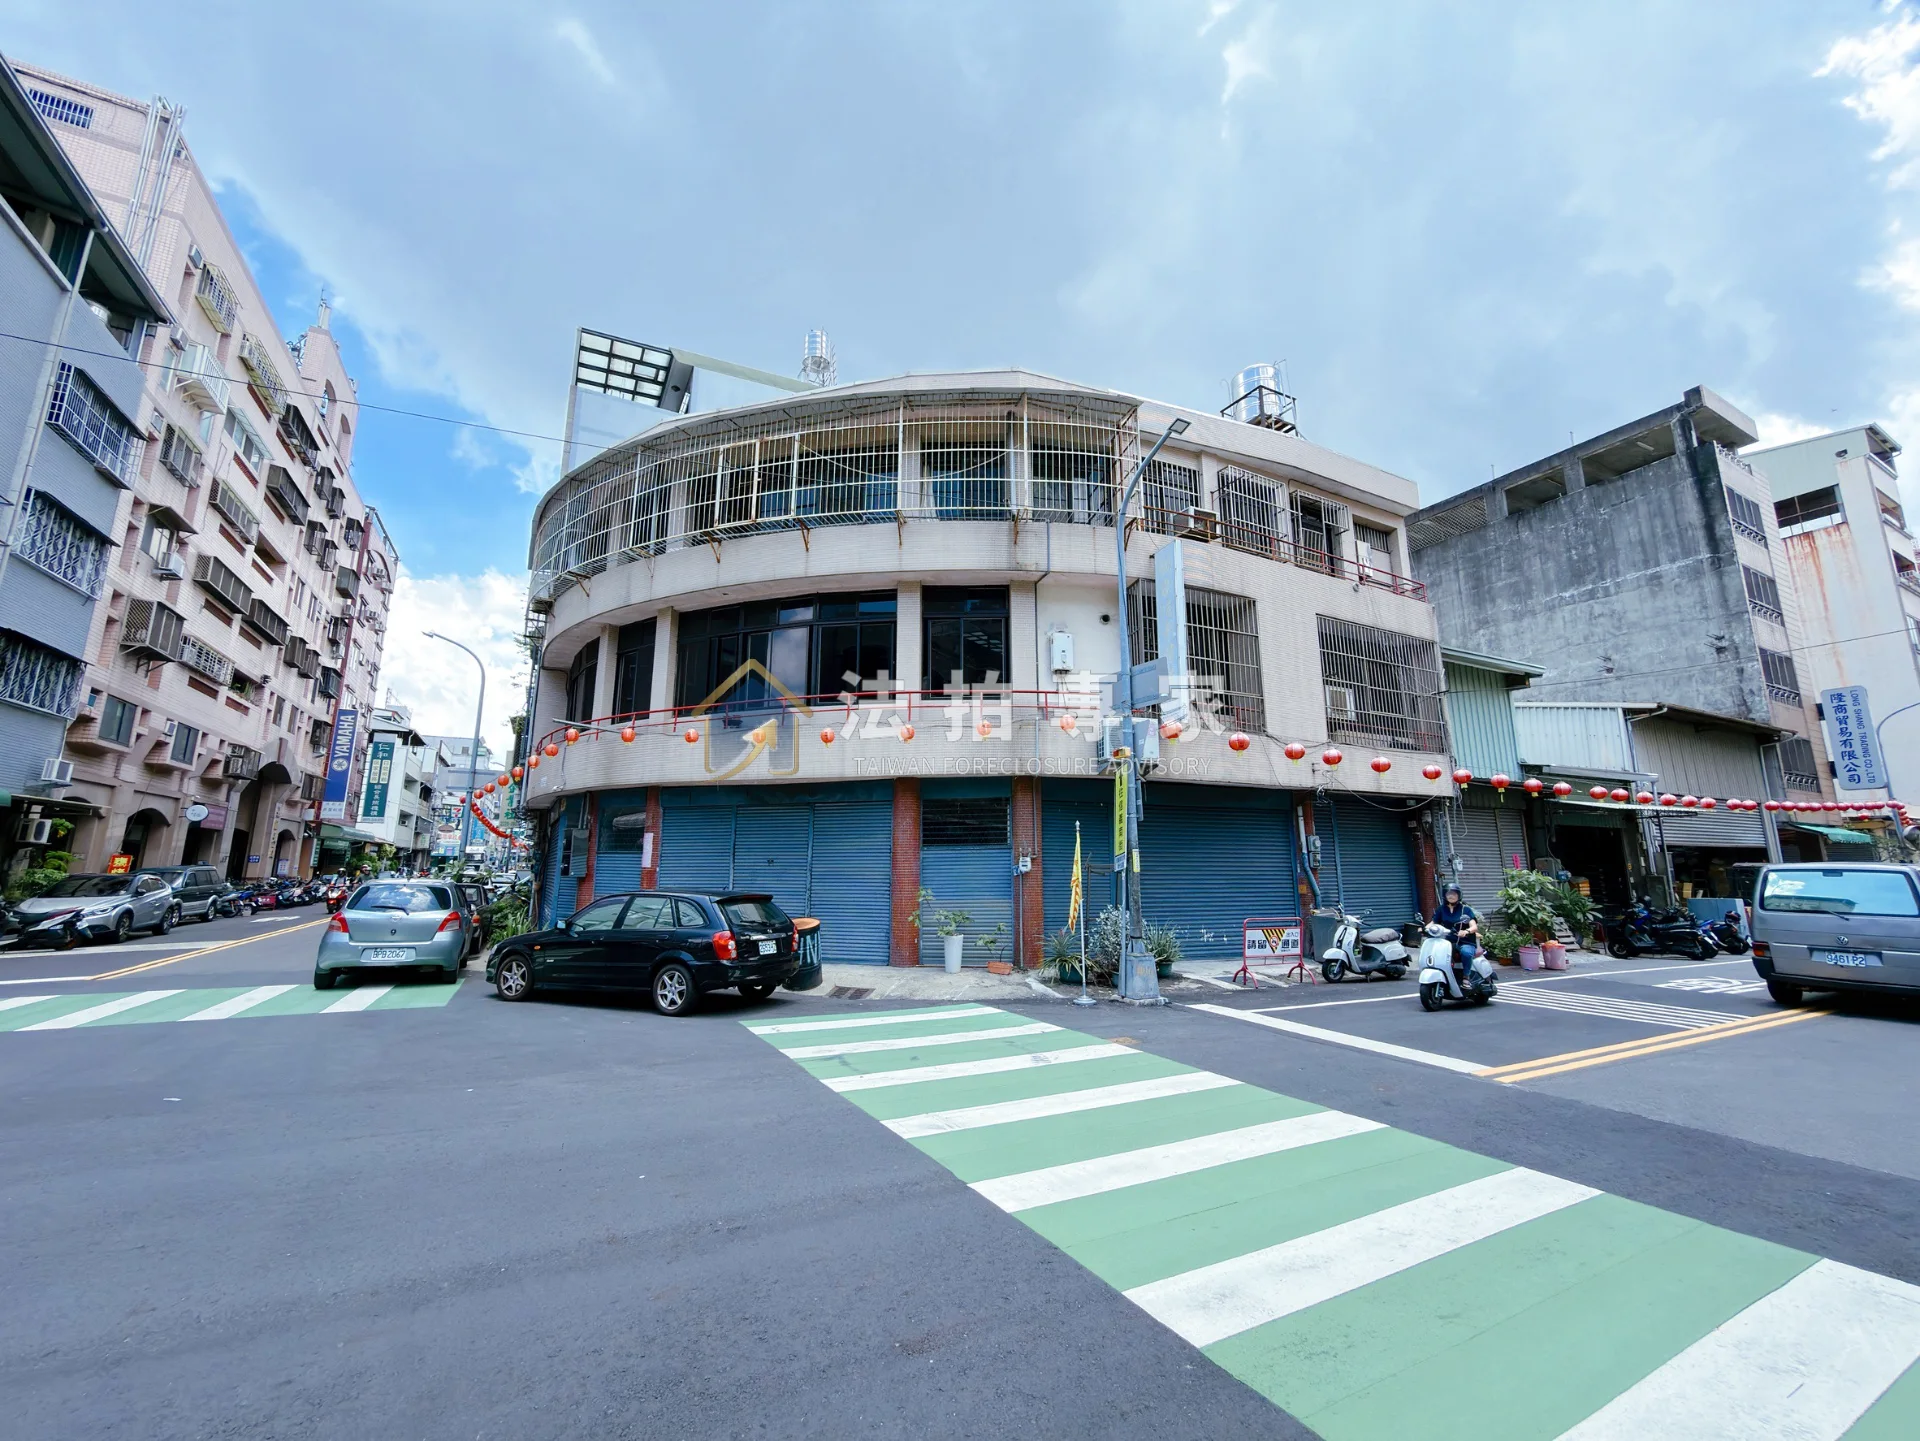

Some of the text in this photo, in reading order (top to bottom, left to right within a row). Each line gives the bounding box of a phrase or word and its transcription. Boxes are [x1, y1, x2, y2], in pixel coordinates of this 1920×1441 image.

[1849, 689, 1861, 707] LONG
[1853, 708, 1865, 730] SHANG
[333, 714, 355, 758] YAMAHA
[1829, 692, 1861, 784] 隆商貿易有限公司
[1858, 731, 1871, 758] TRADING
[1247, 938, 1299, 950] 請留 通道
